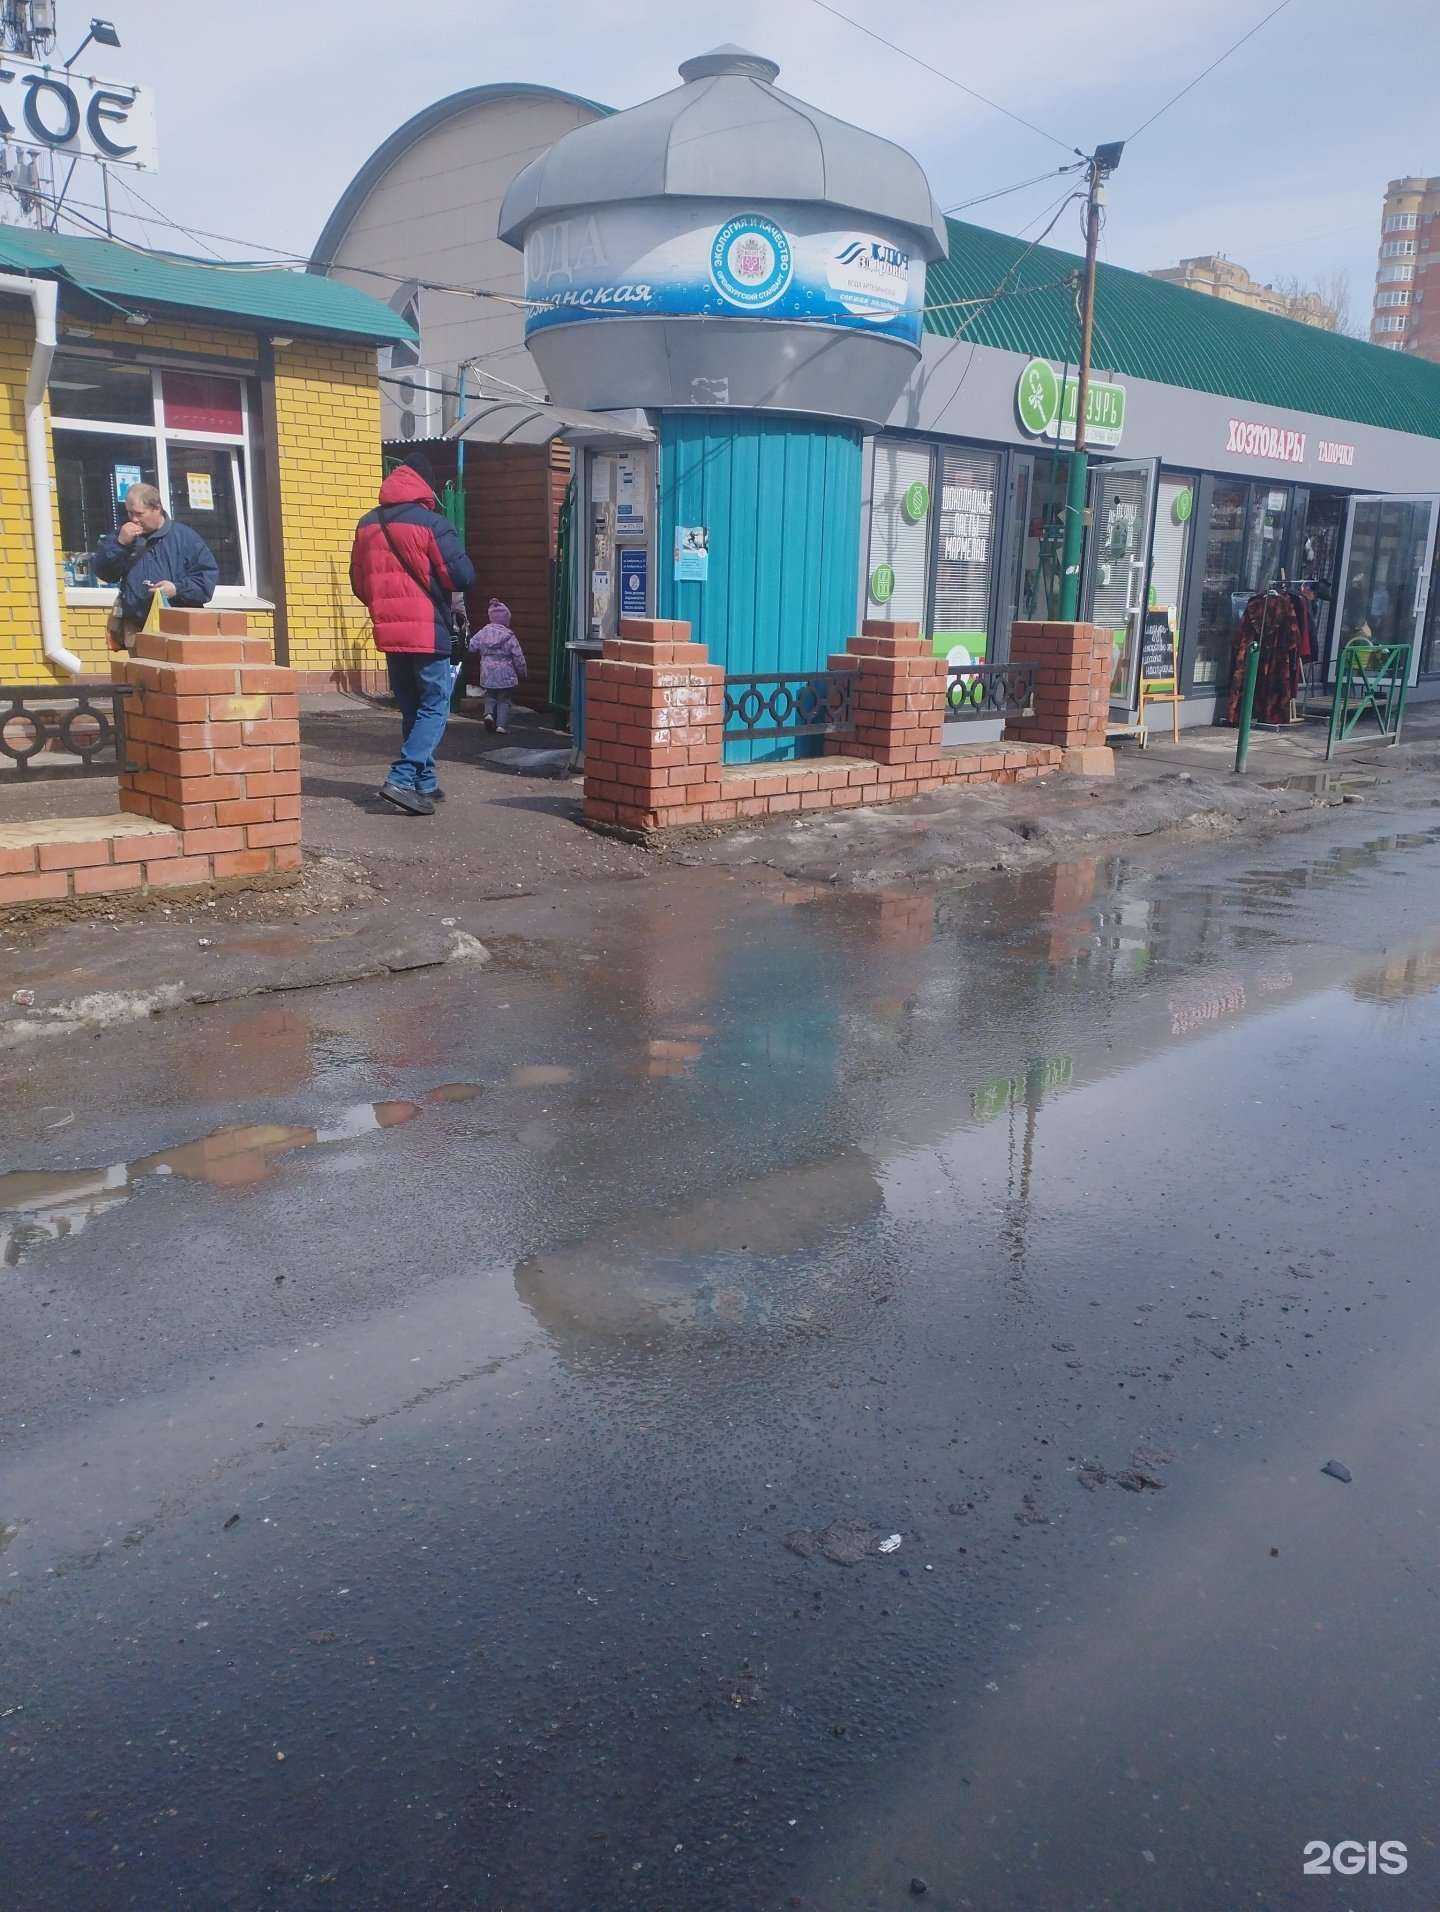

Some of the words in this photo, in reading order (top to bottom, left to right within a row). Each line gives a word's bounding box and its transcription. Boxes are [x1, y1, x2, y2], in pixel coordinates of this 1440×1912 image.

[0, 69, 137, 158] ОЕ
[1226, 418, 1306, 463] ХОЗТОВАРЫ
[1318, 440, 1355, 466] ТАПОЧКИ
